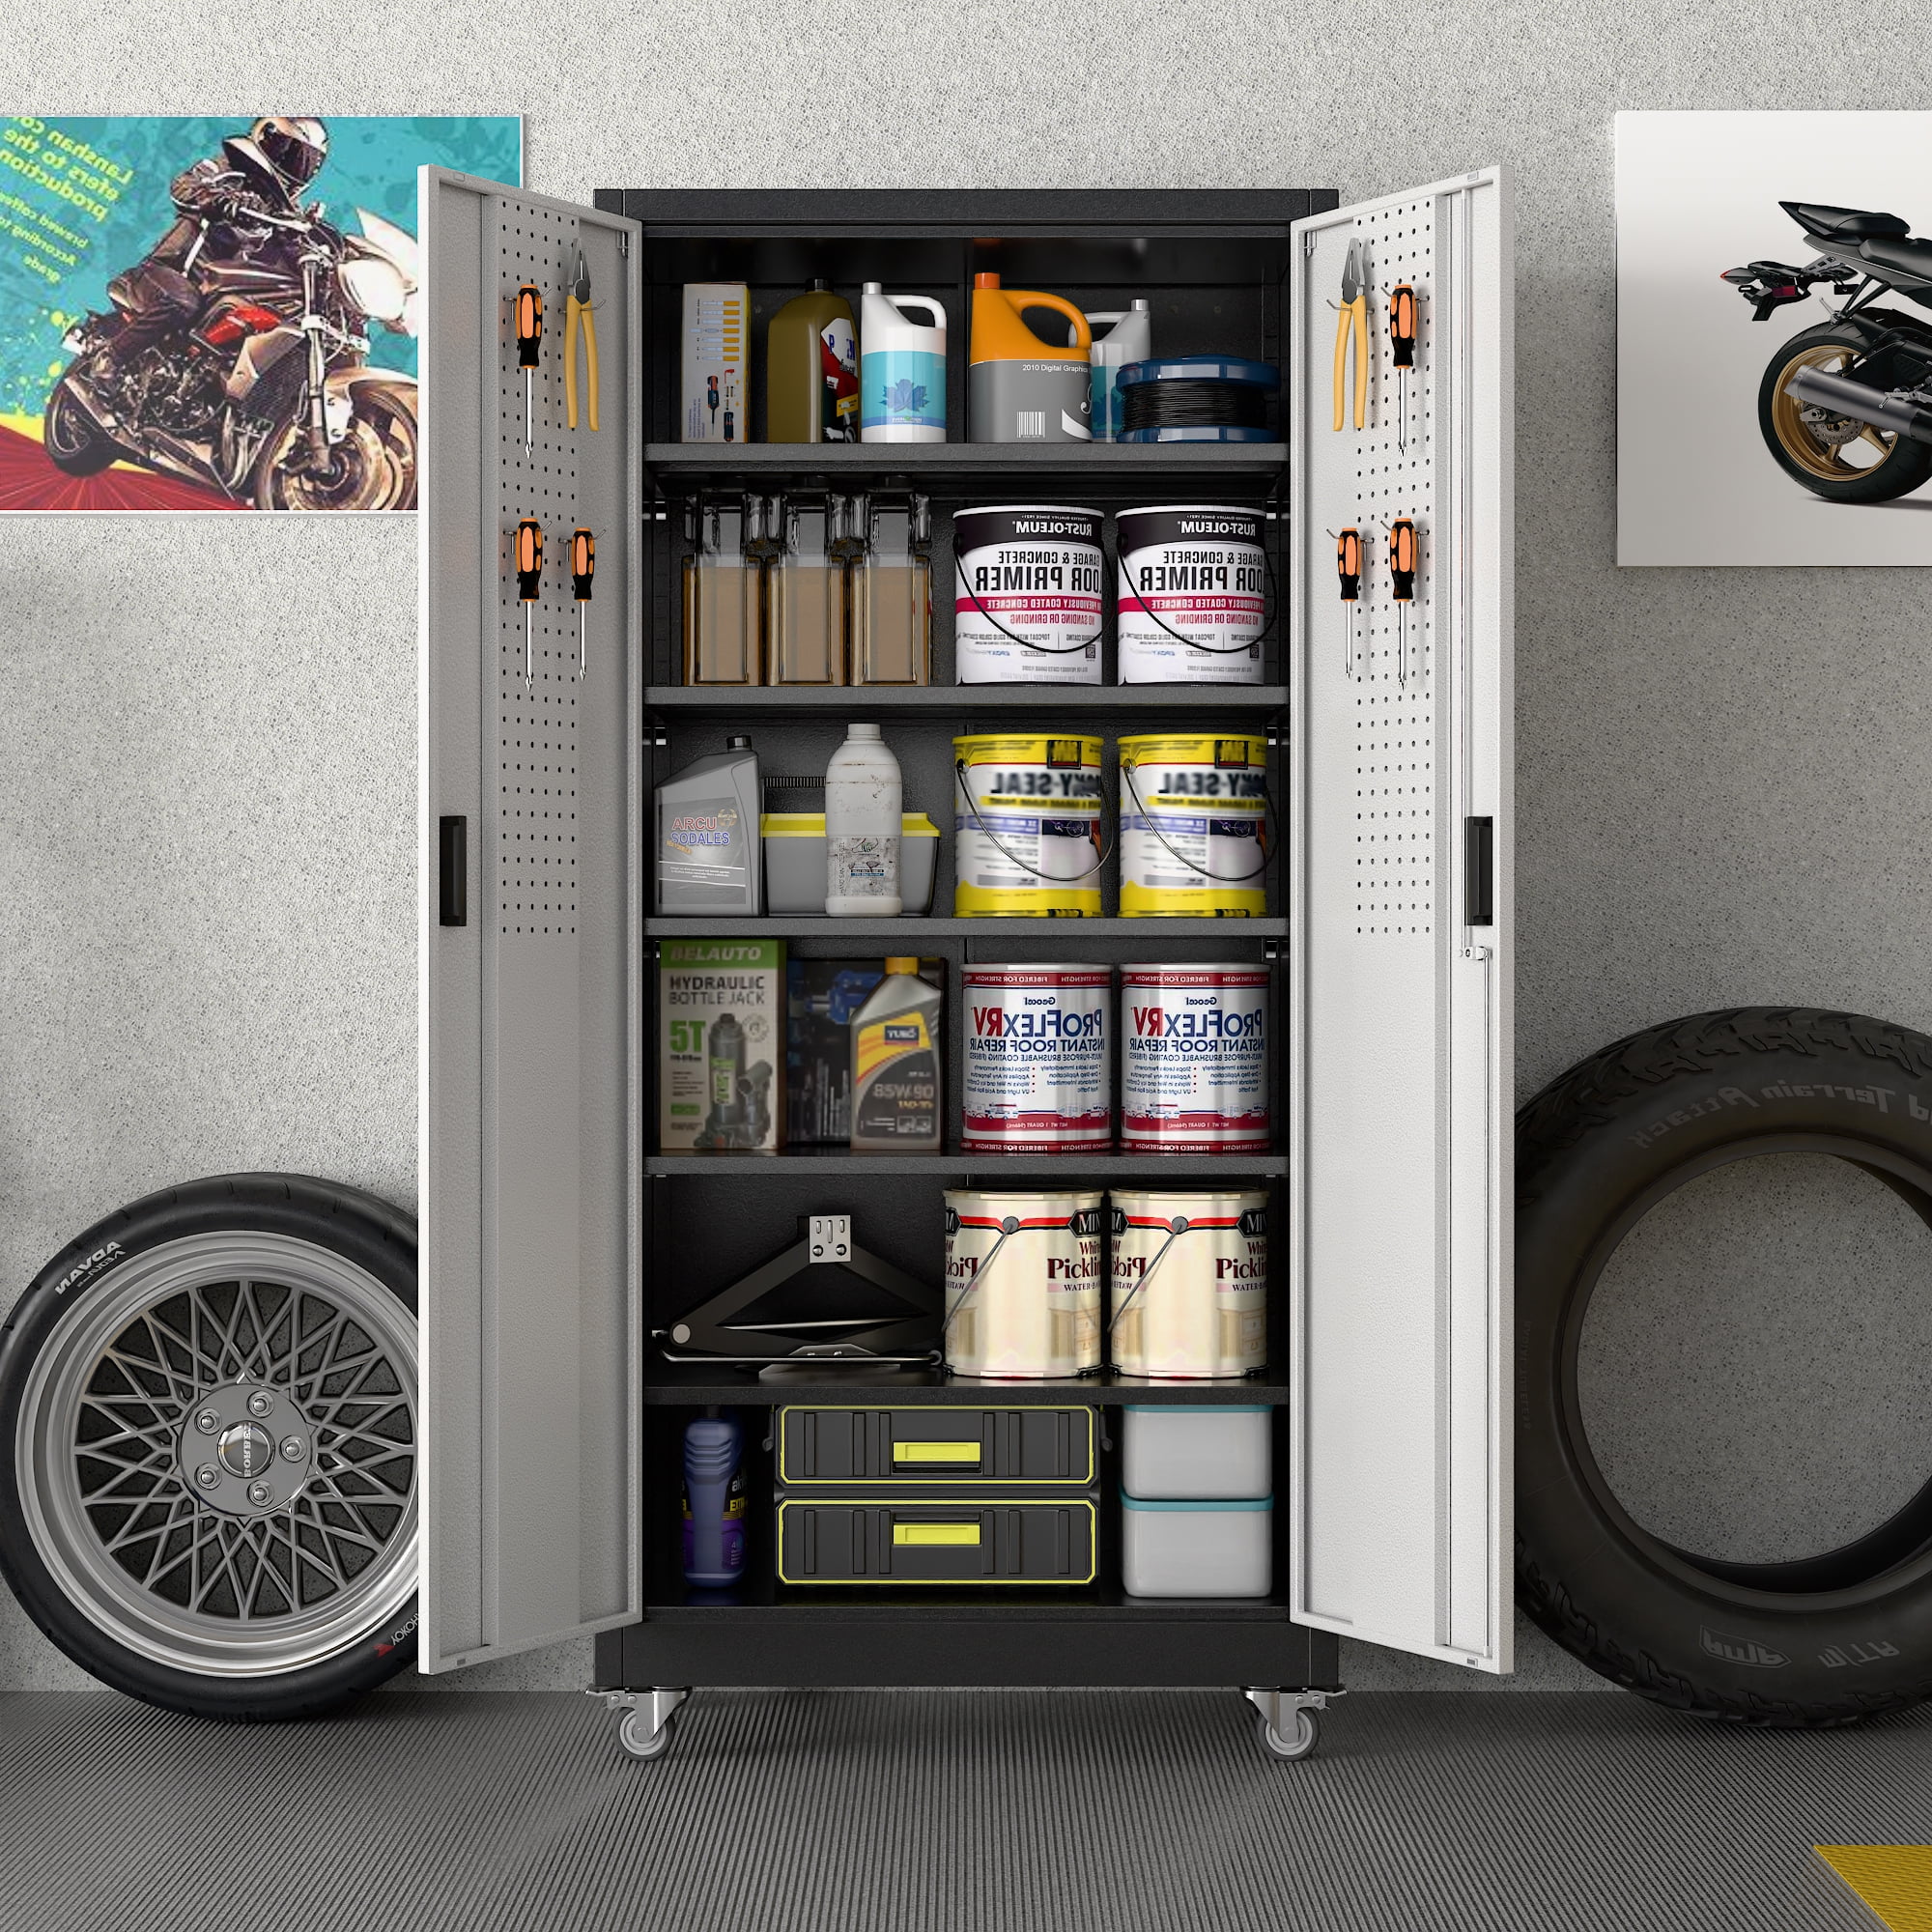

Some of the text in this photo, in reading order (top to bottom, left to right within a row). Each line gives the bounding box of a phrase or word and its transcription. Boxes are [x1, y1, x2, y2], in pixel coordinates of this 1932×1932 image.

[1041, 364, 1062, 373] Digital
[672, 816, 717, 831] ARCU
[671, 832, 730, 845] SODALES
[669, 976, 765, 990] HYDRAULIC
[668, 991, 765, 1006] BOTTLE JACK
[669, 1020, 706, 1053] 5T
